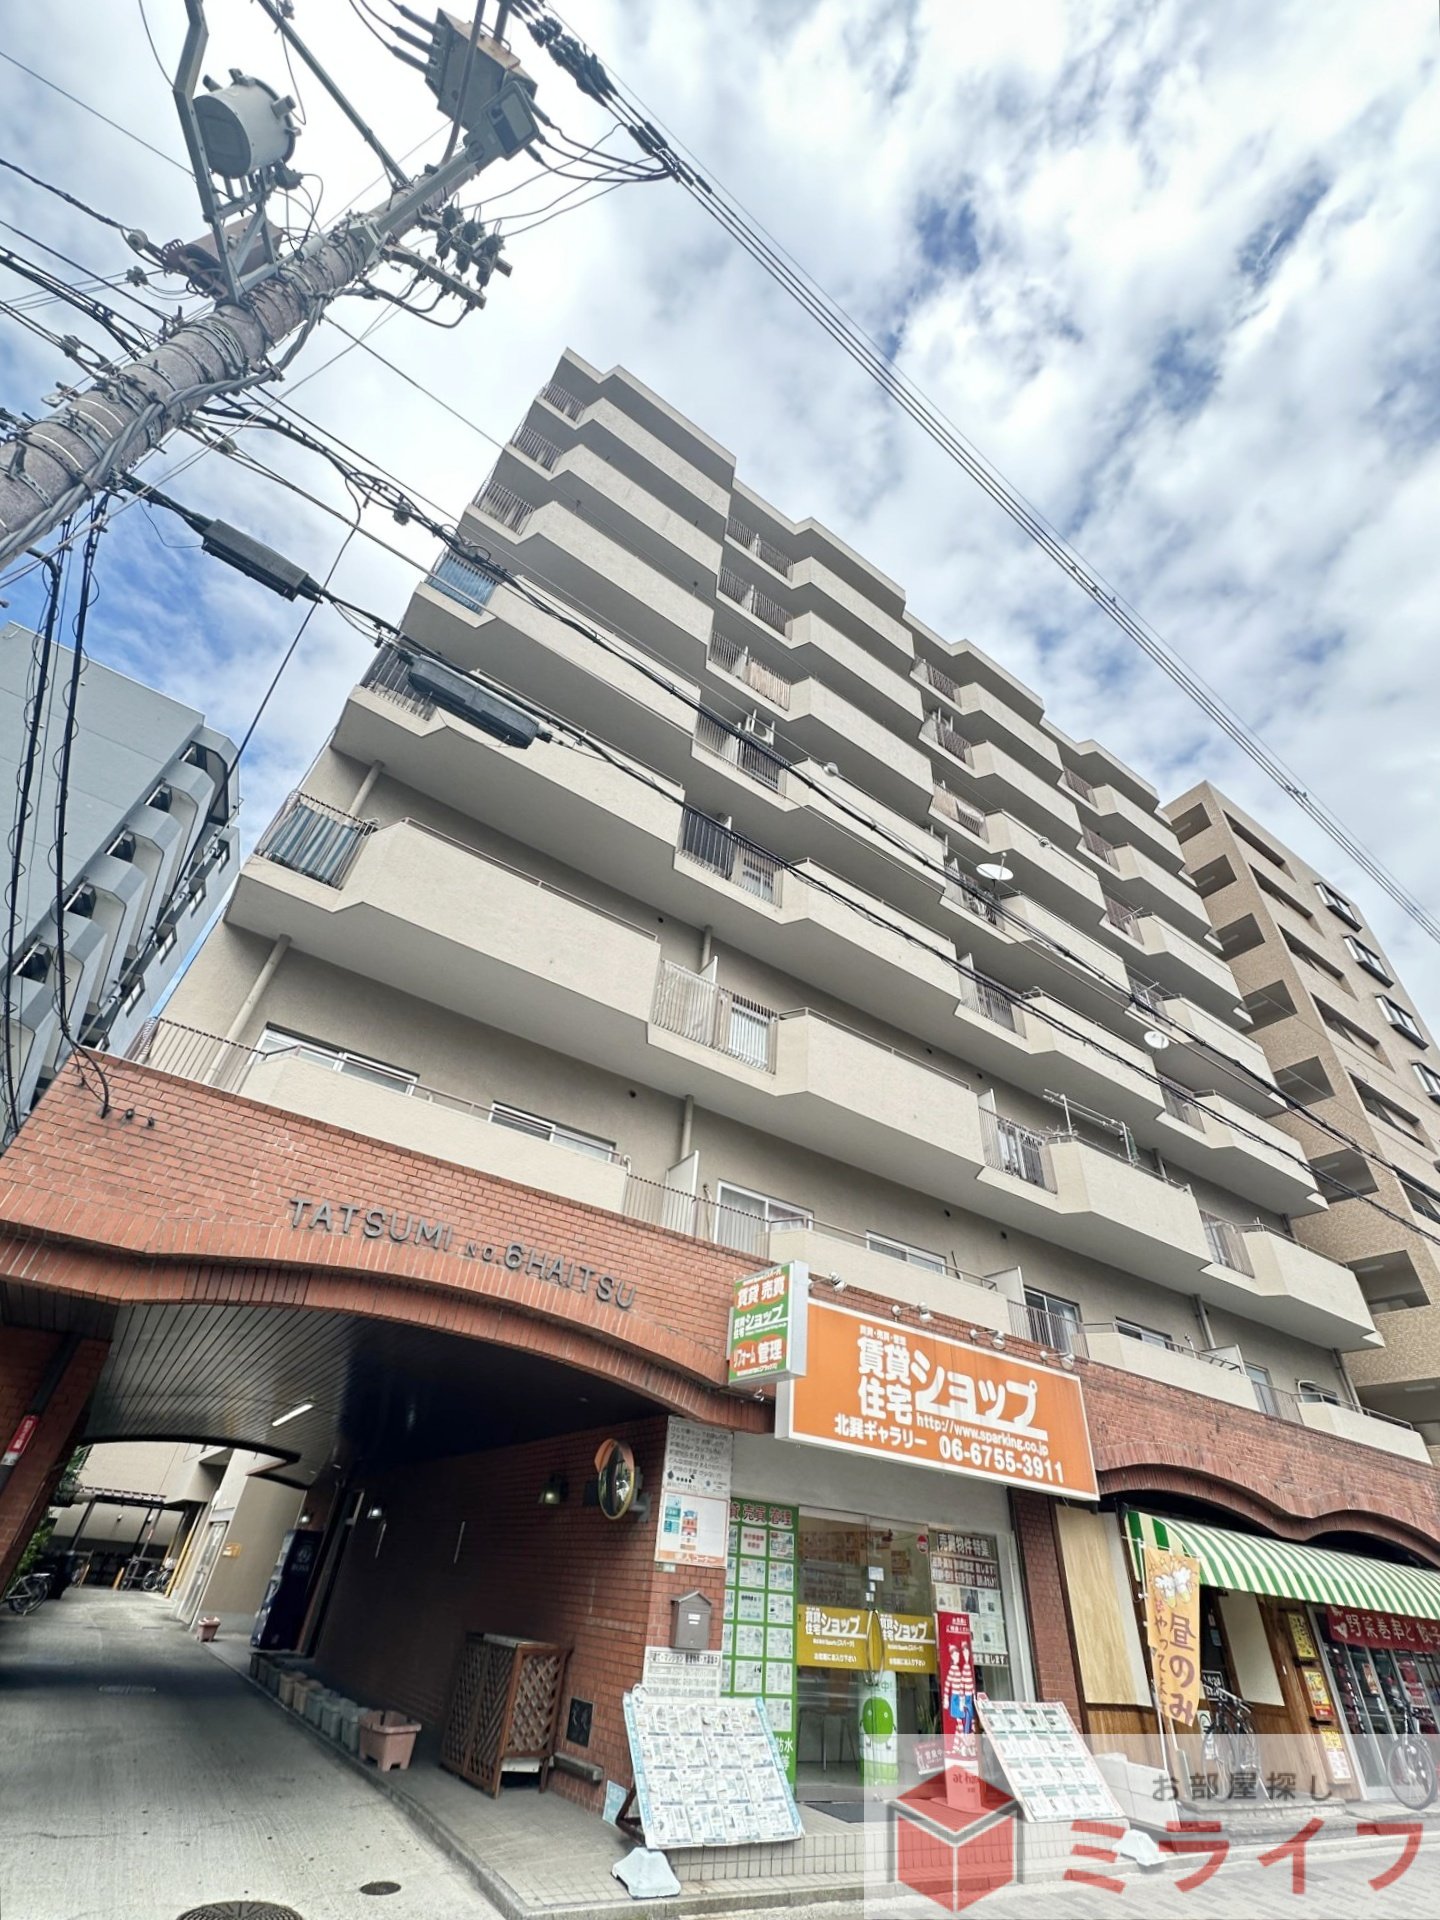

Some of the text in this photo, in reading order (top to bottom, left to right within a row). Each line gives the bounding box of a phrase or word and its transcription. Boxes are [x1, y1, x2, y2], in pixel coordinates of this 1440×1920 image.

[290, 1199, 451, 1252] TATSUMI
[758, 1338, 783, 1364] 管理
[857, 1336, 1038, 1428] 賃貸 ショップ
[857, 1375, 913, 1426] 住宅
[834, 1412, 927, 1449] 北巽ギャラリー
[916, 1412, 1049, 1457] http://www.sparking.co.jp
[939, 1434, 1064, 1484] 06-6755-3911
[820, 1612, 860, 1635] ショップ
[894, 1620, 927, 1639] ショップ
[1169, 1613, 1197, 1727] 昼のみ
